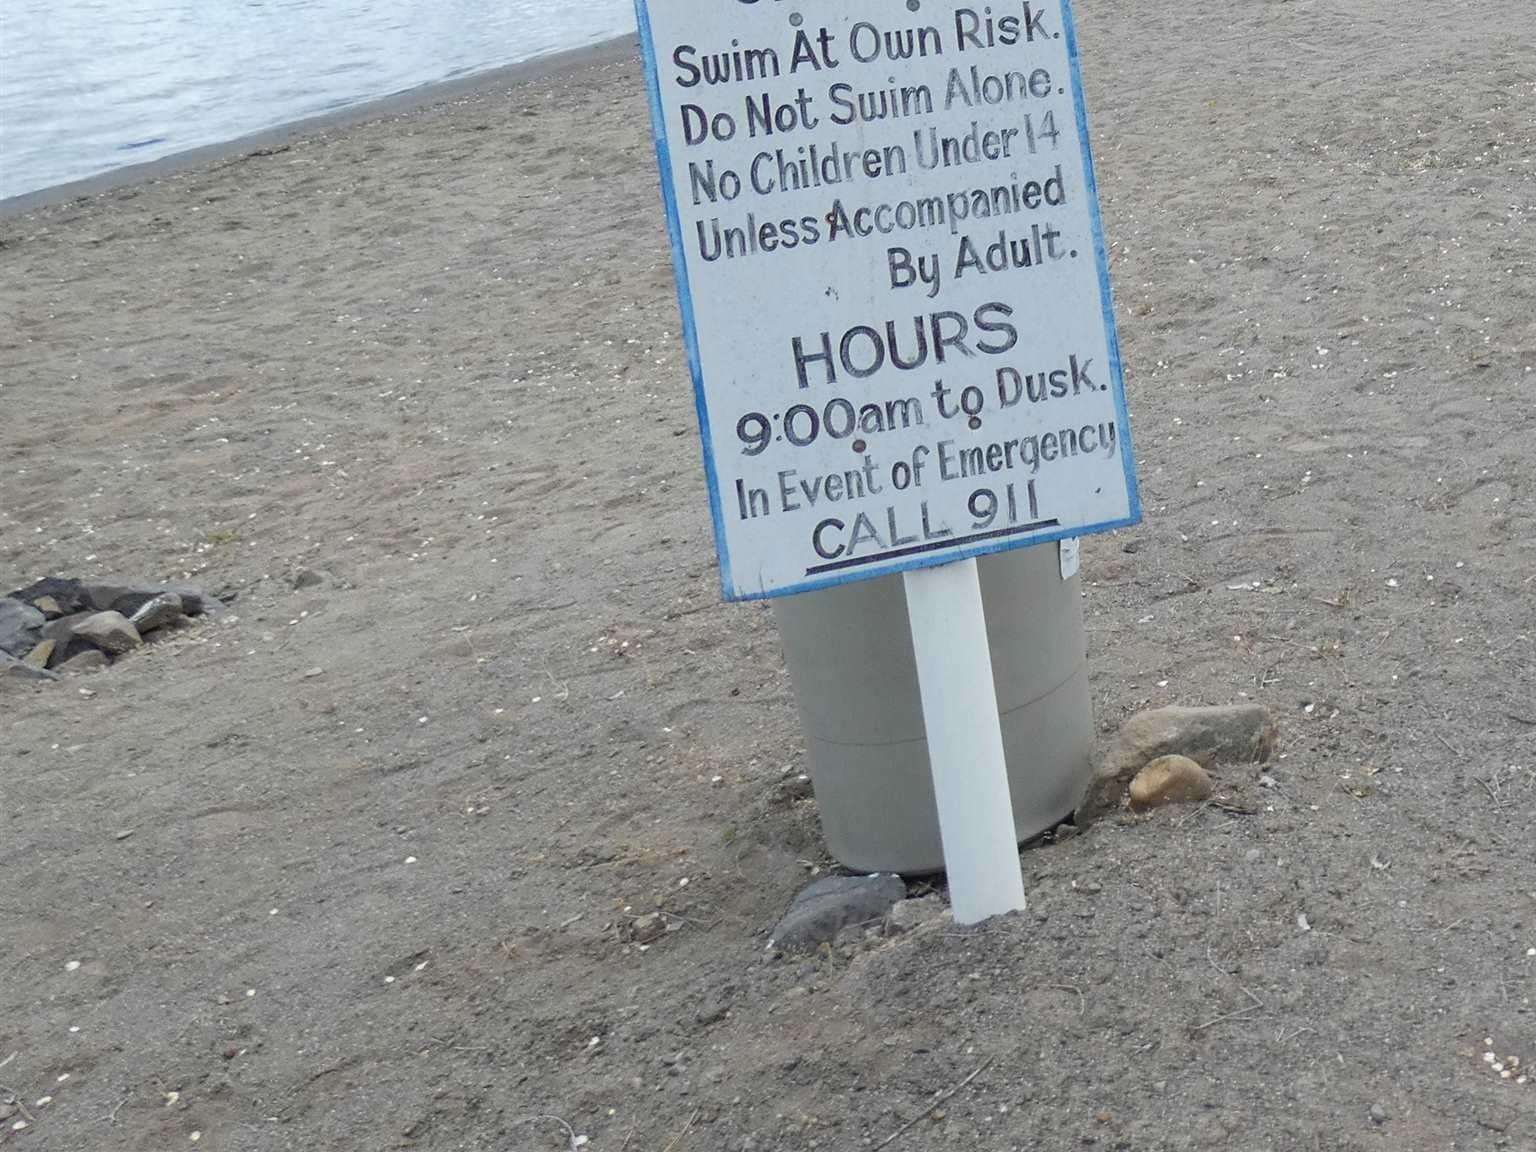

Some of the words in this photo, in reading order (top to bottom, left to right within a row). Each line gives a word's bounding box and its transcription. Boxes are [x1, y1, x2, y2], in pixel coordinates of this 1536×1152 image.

[672, 38, 779, 88] Swim
[789, 25, 839, 74] At
[849, 21, 942, 64] Own
[954, 1, 1060, 51] Risk.
[680, 103, 736, 146] Do
[747, 88, 819, 138] Not
[828, 77, 934, 125] Swim
[944, 65, 1065, 111] Alone.
[689, 159, 741, 205] No
[750, 140, 907, 196] Children
[913, 121, 1019, 170] Under
[1023, 110, 1060, 154] 14
[696, 212, 820, 262] Unless
[829, 164, 1067, 242] Accompanied
[887, 247, 940, 298] By
[954, 222, 1078, 279] Adult.
[791, 301, 1019, 388] HOURS
[736, 394, 924, 456] 9:00am
[930, 379, 985, 419] to
[996, 354, 1108, 409] Dusk.
[736, 478, 770, 520] In
[778, 453, 883, 513] Event
[892, 444, 930, 491] of
[938, 420, 1117, 481] Emergency
[811, 500, 954, 560] CALL
[966, 478, 1039, 529] 911
